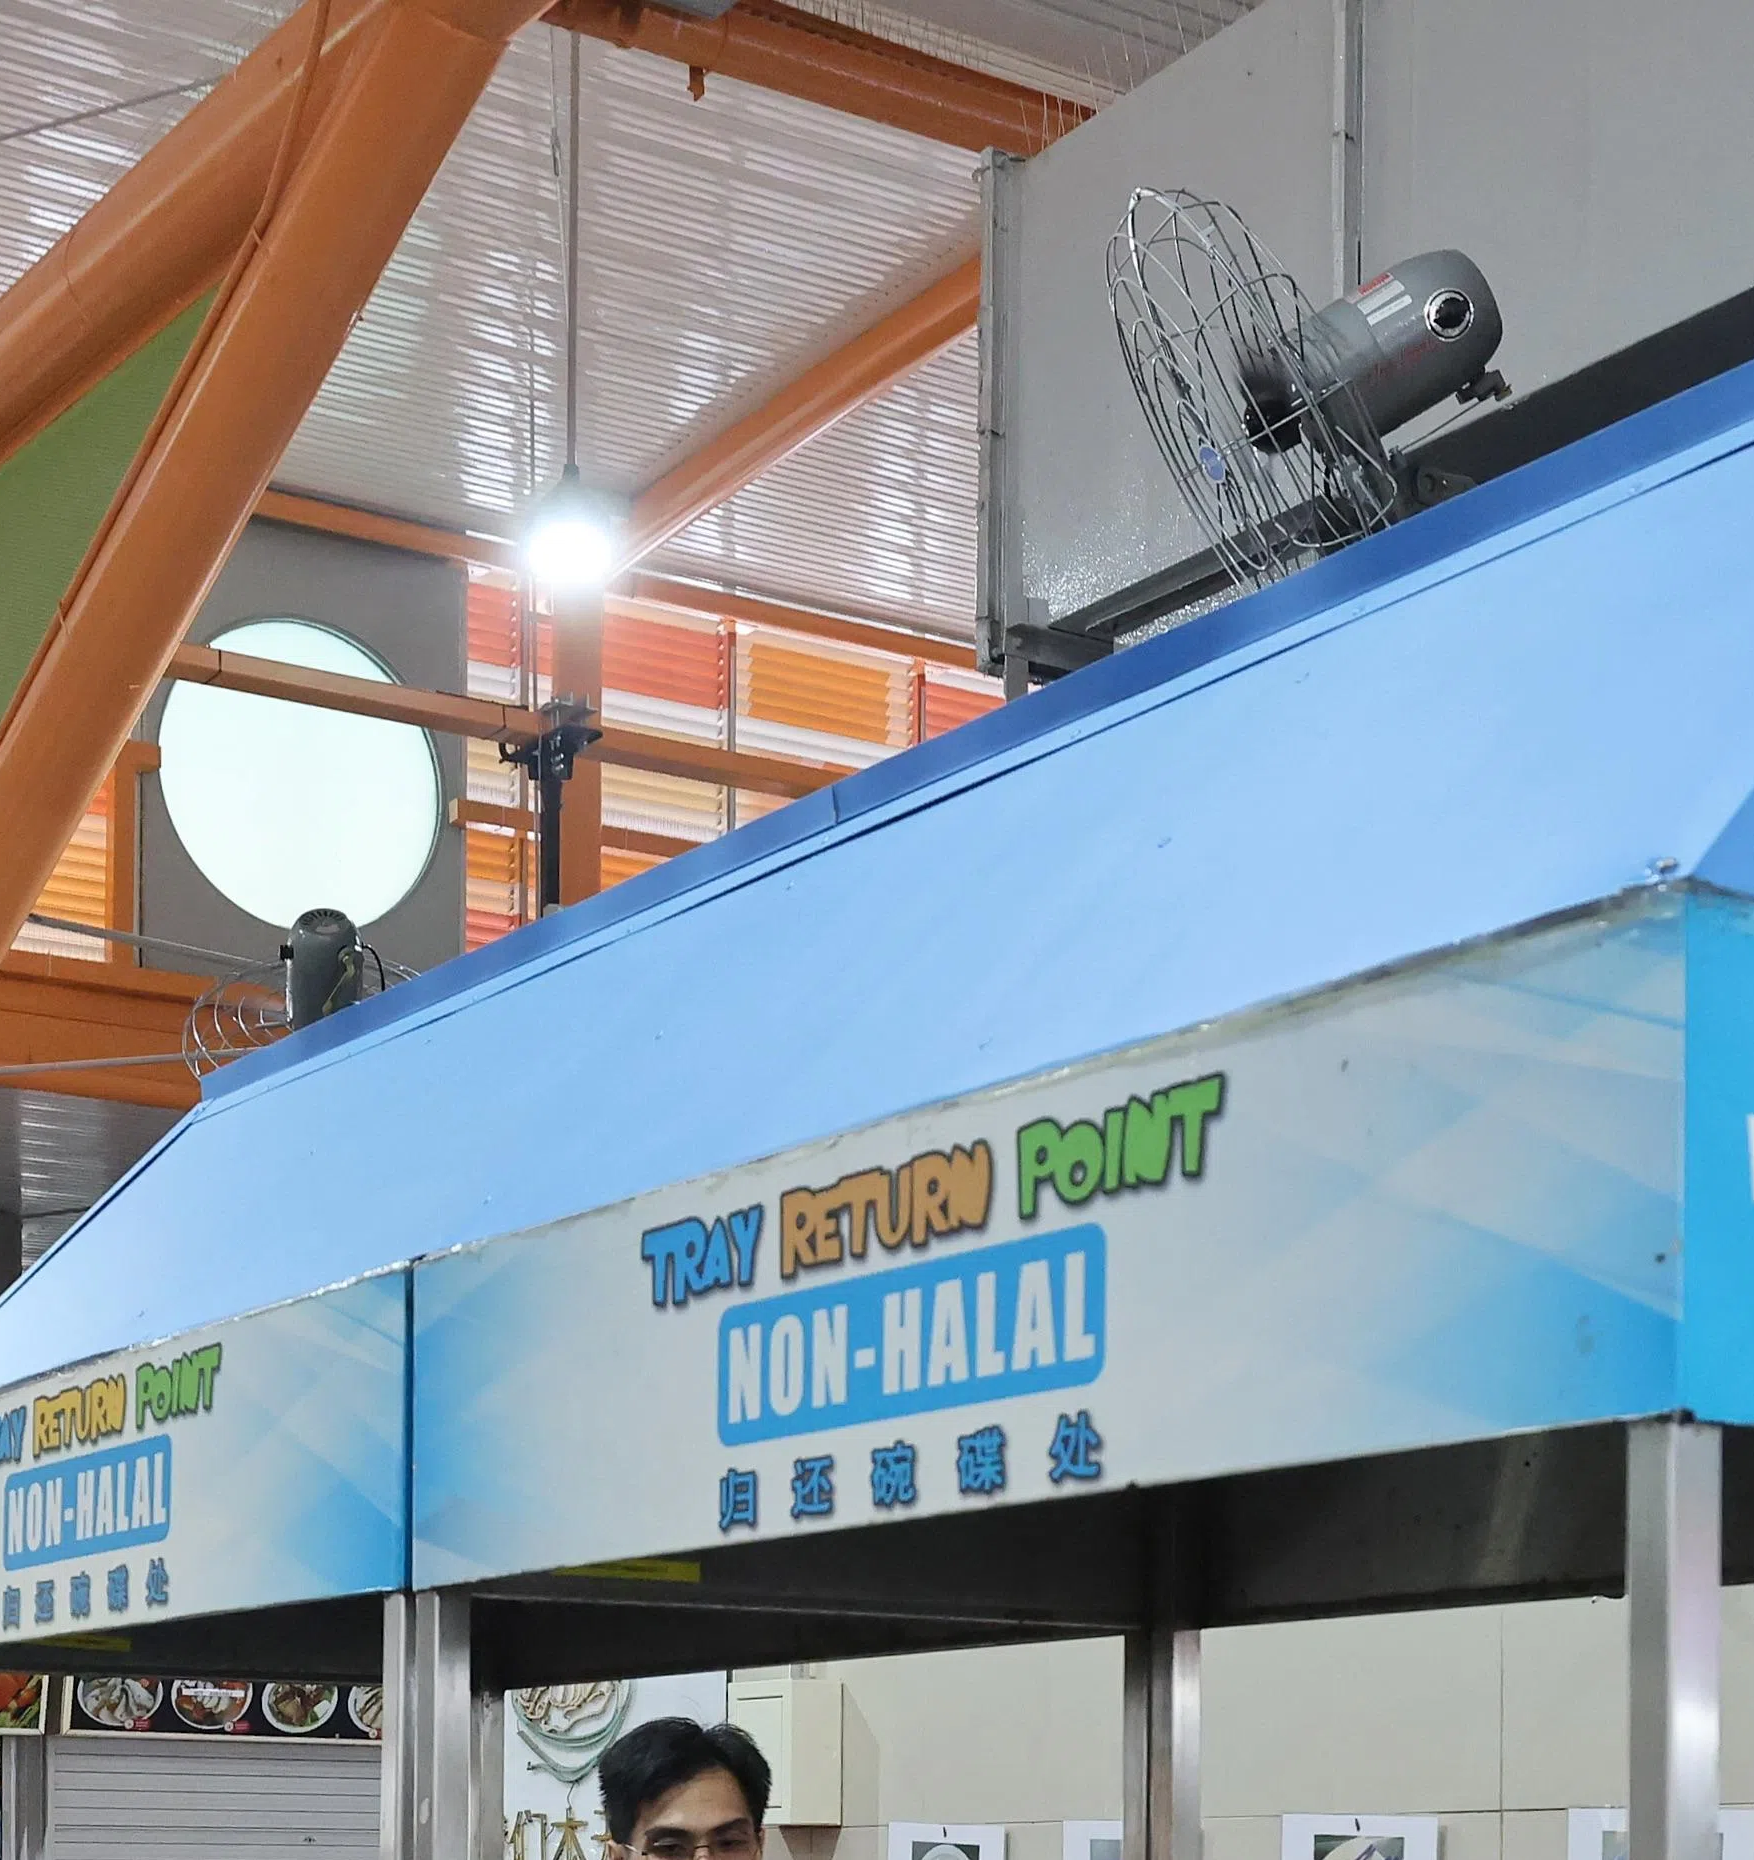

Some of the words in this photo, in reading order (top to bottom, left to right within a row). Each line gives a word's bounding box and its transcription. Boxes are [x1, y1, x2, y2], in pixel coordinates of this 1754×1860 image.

[642, 1202, 765, 1307] TRAY
[780, 1138, 994, 1280] RETURN
[1017, 1073, 1225, 1220] POINT
[727, 1250, 1096, 1425] NON-HALAL
[33, 1373, 127, 1458] RETURN
[135, 1342, 223, 1429] POINT
[7, 1452, 167, 1555] NON-HALAL
[718, 1410, 1105, 1533] 归还碗碟处
